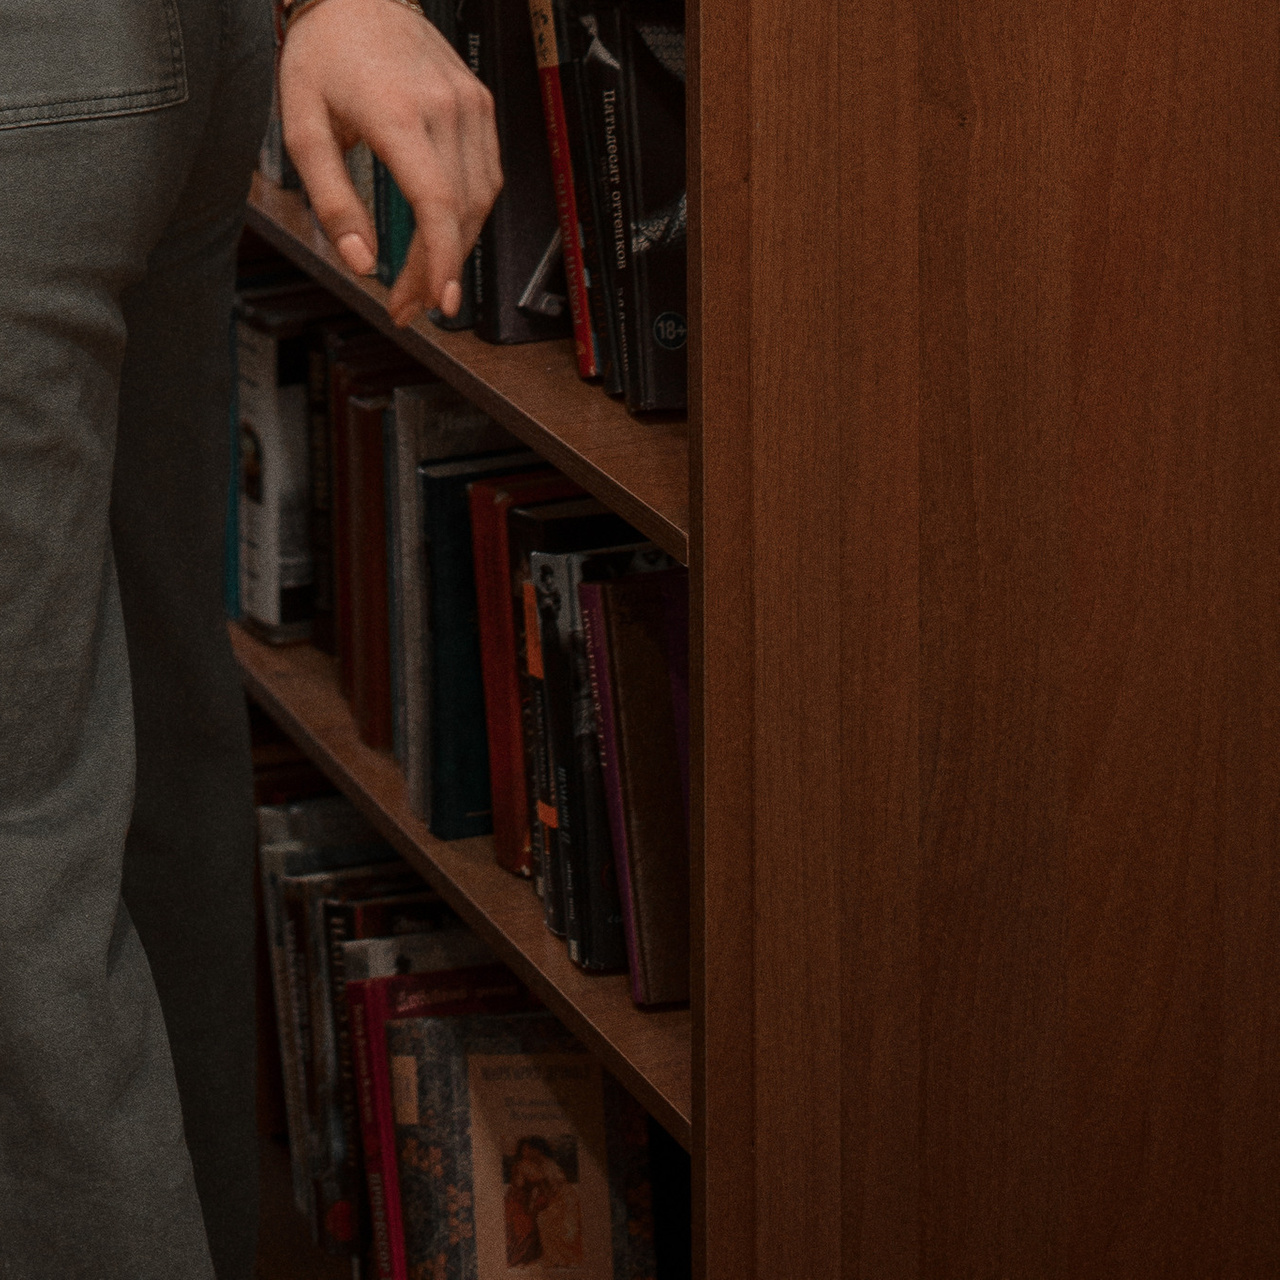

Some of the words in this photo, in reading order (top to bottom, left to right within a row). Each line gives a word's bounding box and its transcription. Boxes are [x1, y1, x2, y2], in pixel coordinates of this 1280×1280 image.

[600, 88, 623, 184] Пятьдесят
[554, 171, 574, 249] ПОТЕРЬ
[609, 189, 628, 270] оттенков
[566, 254, 583, 325] РОМАН
[657, 319, 688, 341] 18+
[368, 1171, 398, 1274] ПРОФЕССОР
